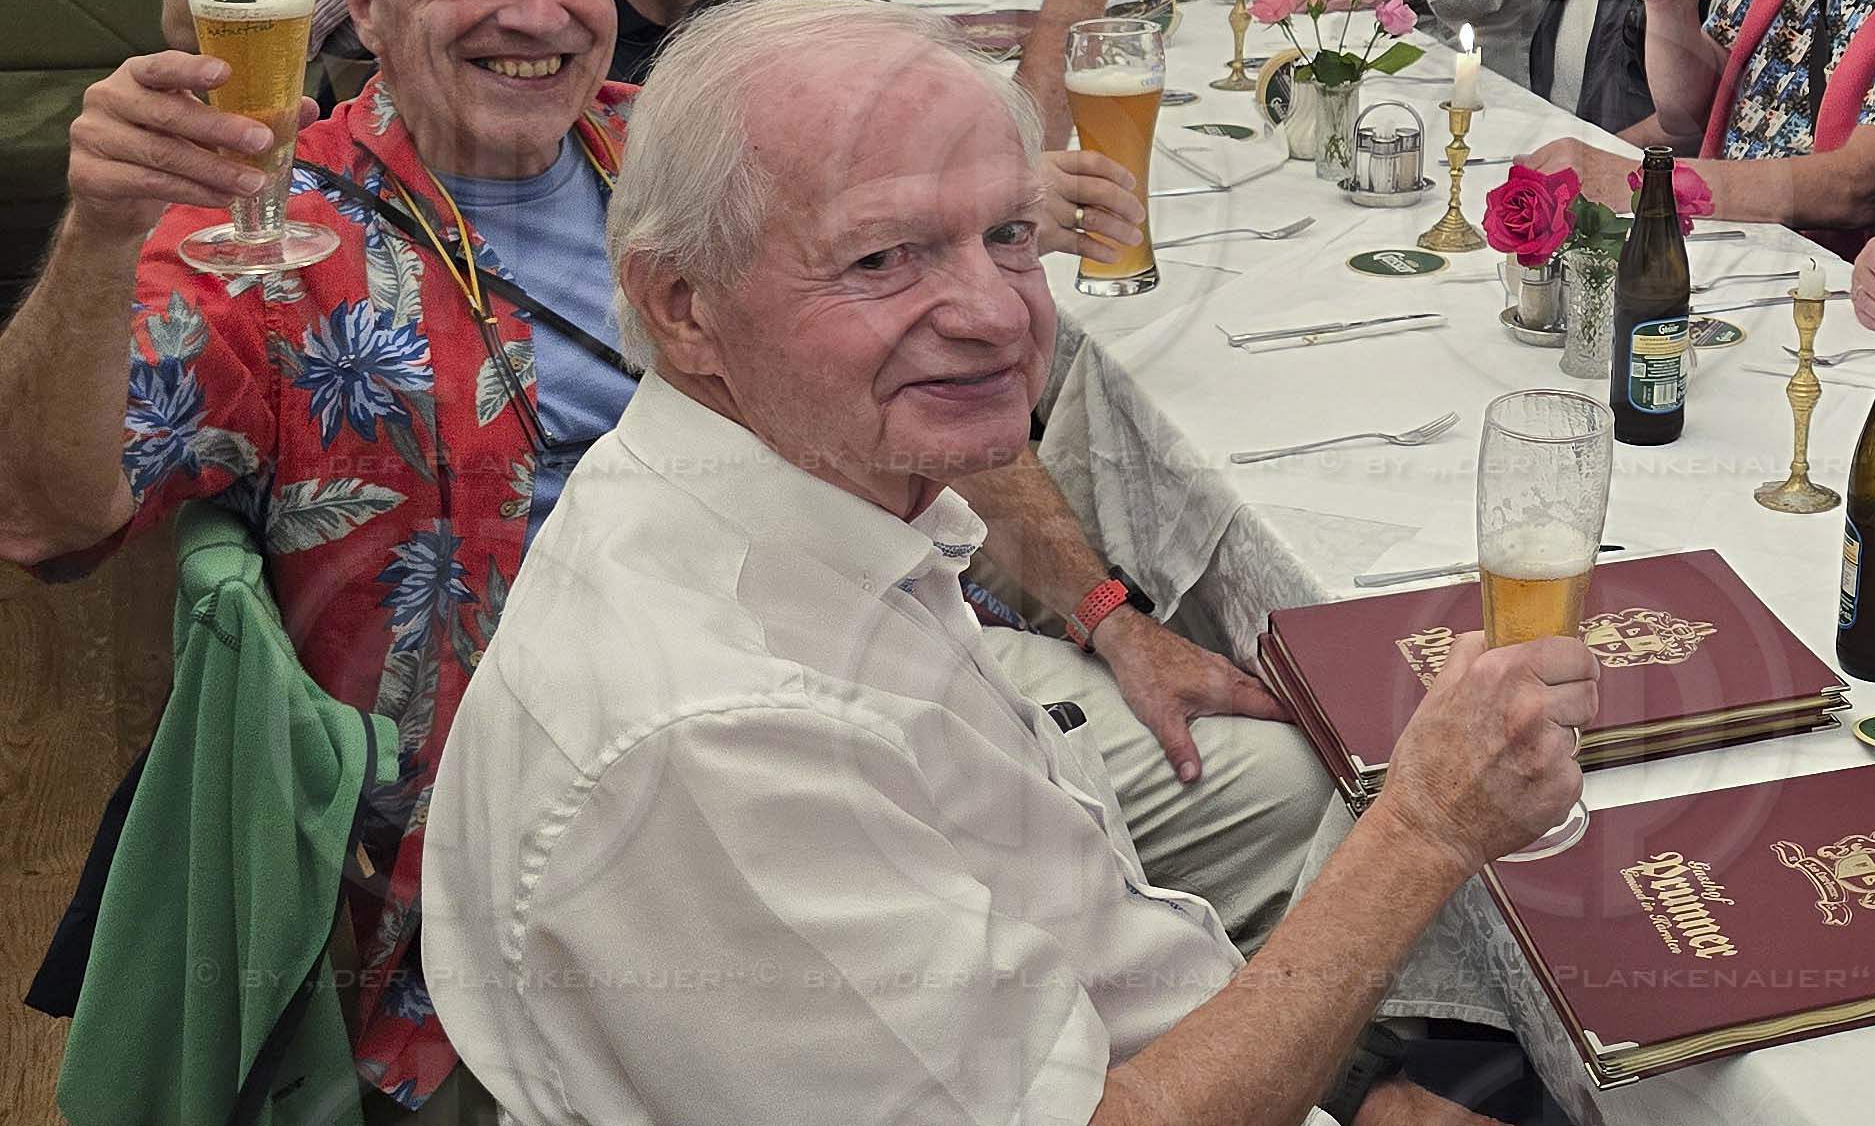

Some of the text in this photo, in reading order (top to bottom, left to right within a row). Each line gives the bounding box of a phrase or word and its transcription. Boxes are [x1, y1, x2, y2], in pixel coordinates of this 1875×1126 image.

[1629, 851, 1739, 959] Prunner
[1687, 860, 1735, 906] Gasthof
[1641, 901, 1656, 912] in
